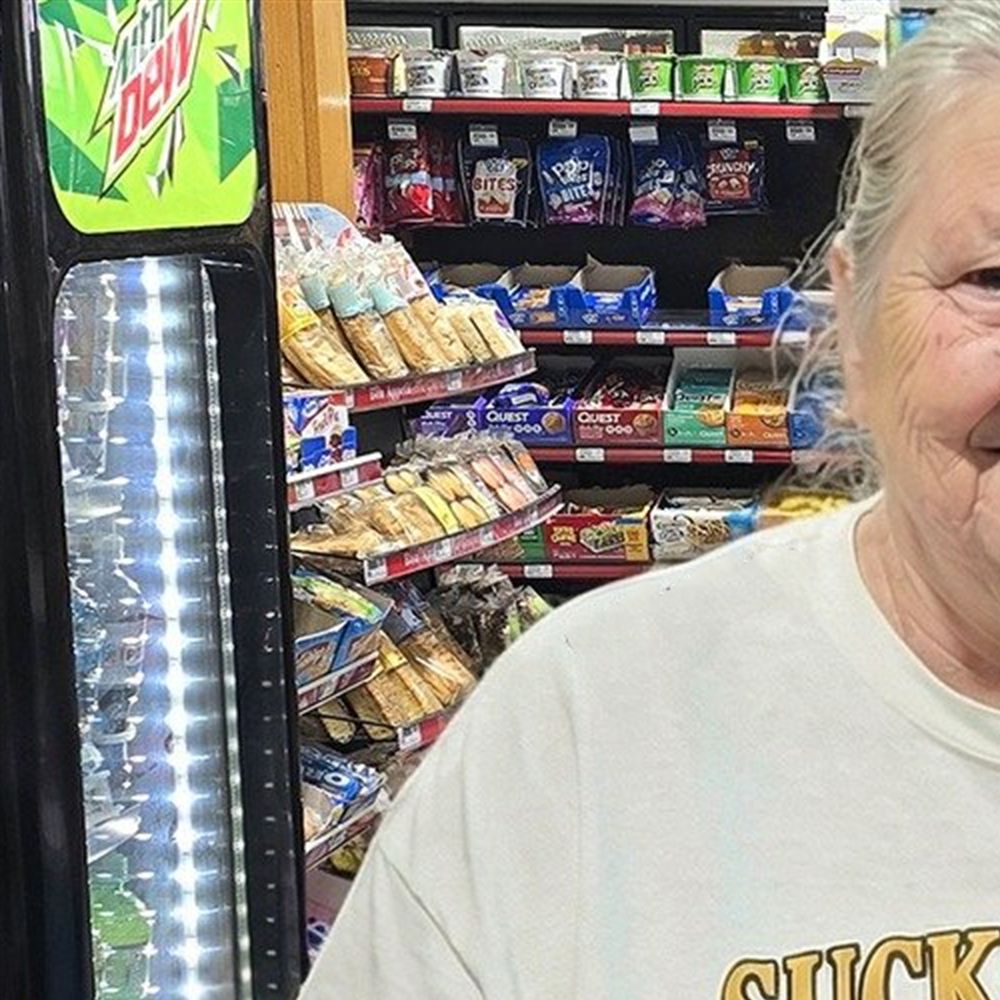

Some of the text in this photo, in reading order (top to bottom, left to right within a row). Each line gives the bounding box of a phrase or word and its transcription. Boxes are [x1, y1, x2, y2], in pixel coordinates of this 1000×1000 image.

[473, 178, 516, 191] BITES
[486, 410, 529, 422] QUEST
[577, 411, 621, 424] QUEST
